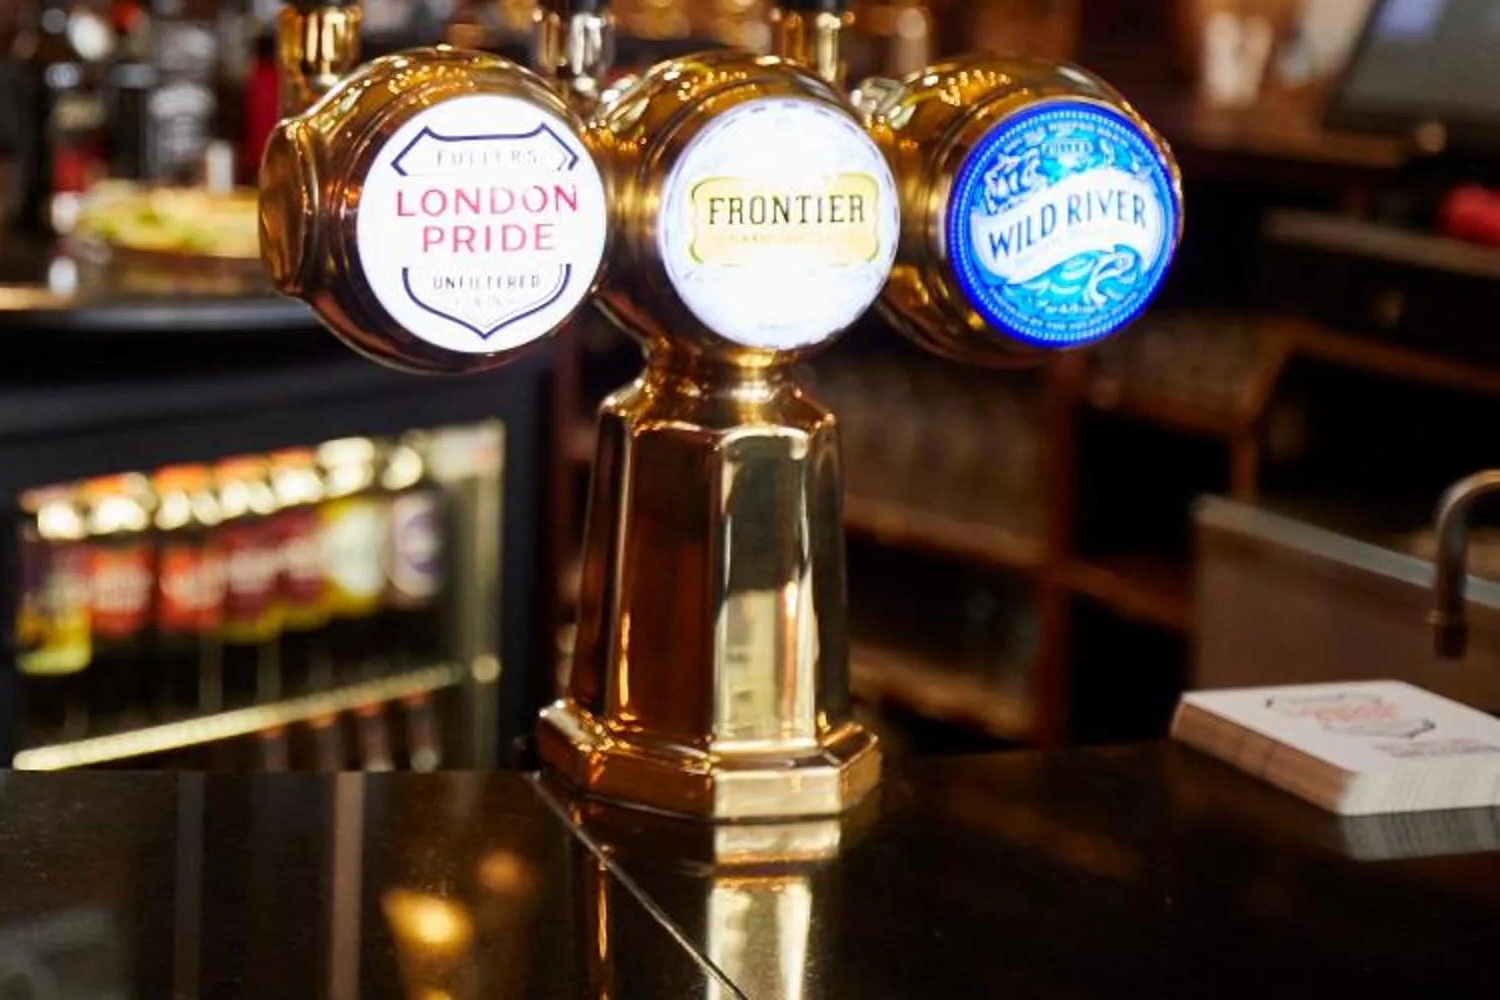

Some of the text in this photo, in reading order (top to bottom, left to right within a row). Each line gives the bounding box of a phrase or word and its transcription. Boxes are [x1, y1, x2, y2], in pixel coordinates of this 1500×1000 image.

[396, 184, 579, 218] LONDON
[708, 194, 866, 226] FRONTIER
[421, 223, 558, 254] PRIDE
[987, 189, 1148, 265] WILD RIVER
[432, 274, 542, 290] UNFILTERED
